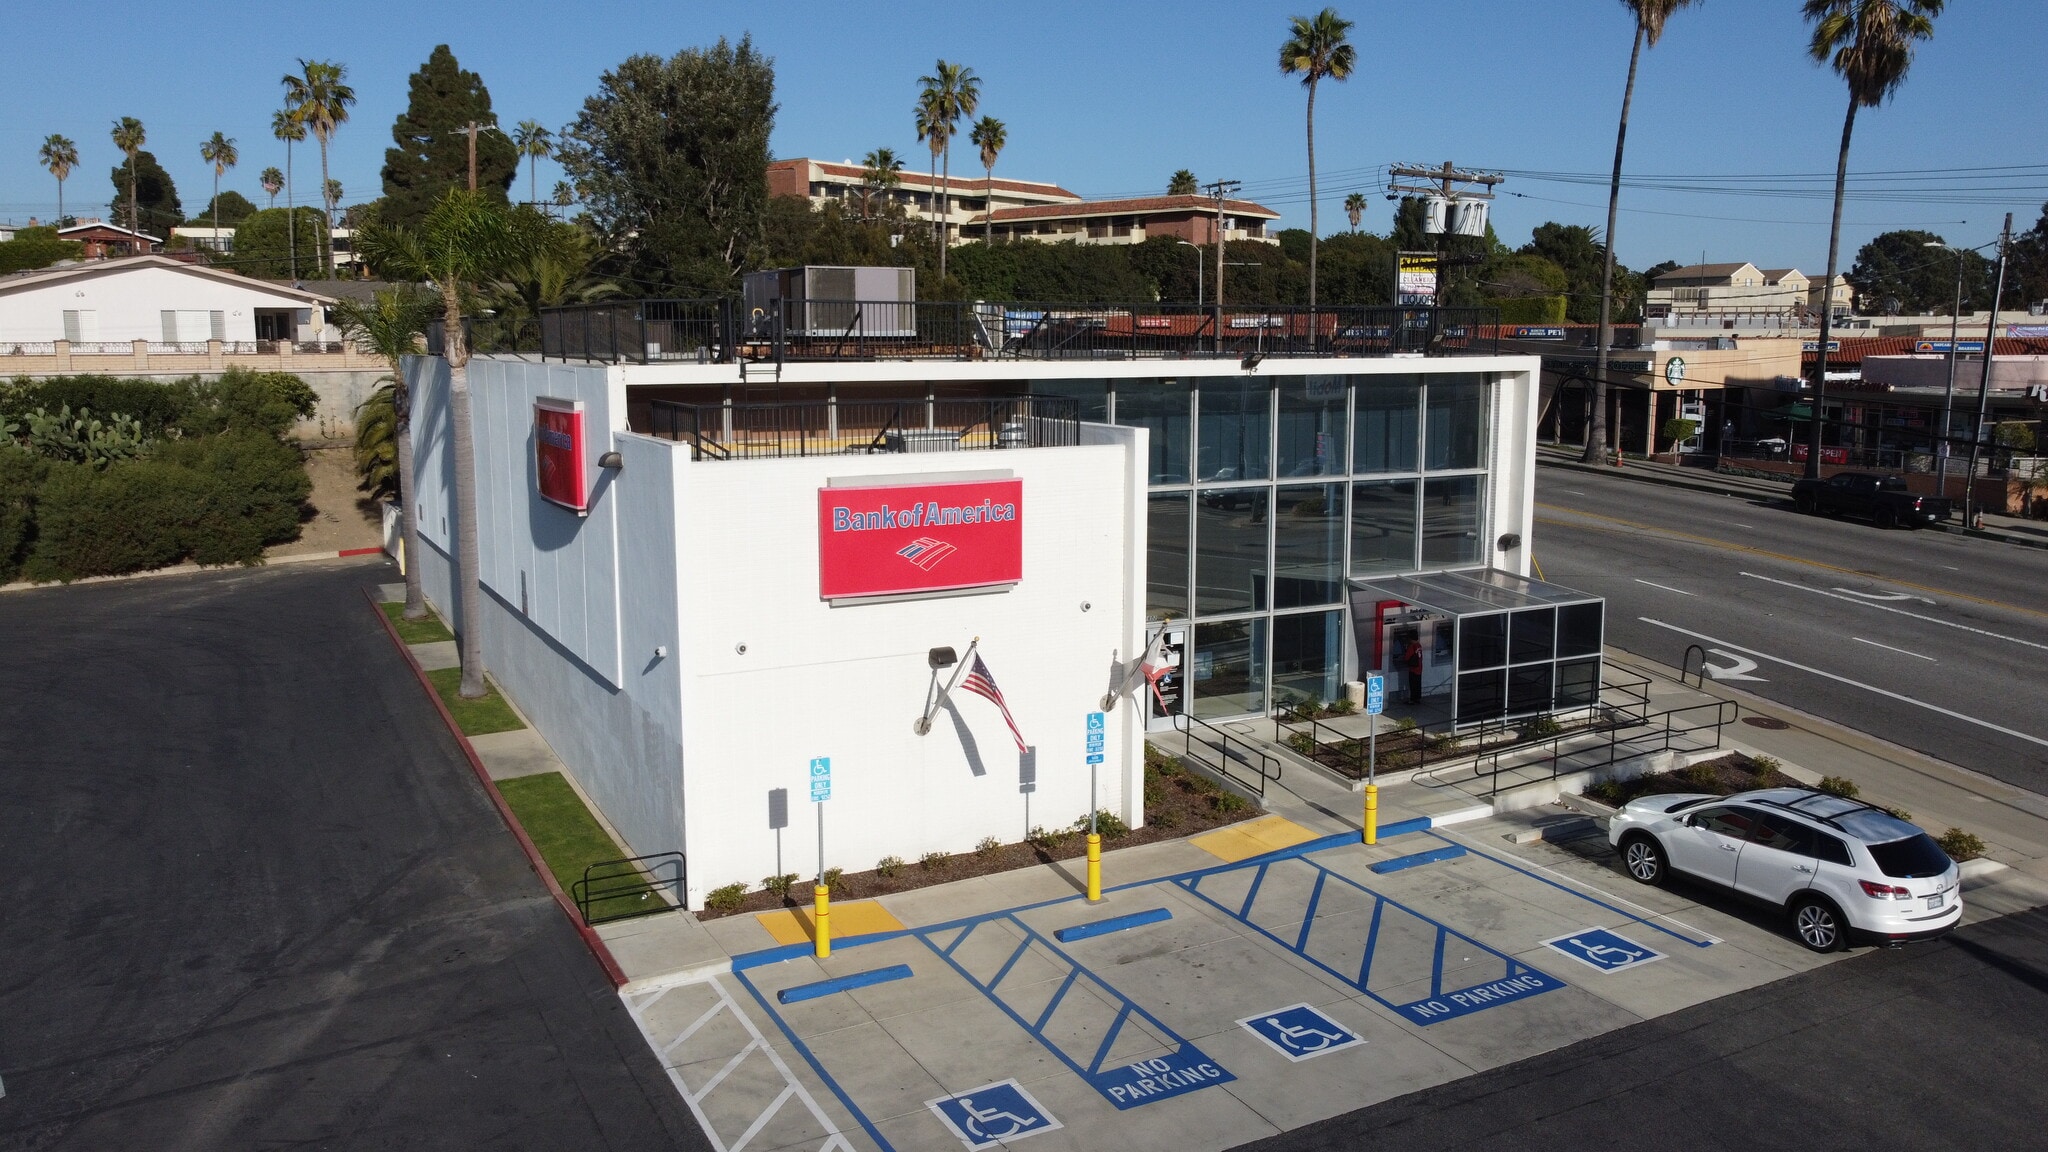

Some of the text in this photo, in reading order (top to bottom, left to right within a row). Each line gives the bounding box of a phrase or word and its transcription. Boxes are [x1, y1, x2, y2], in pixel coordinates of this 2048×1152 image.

[1402, 294, 1436, 304] LIQUOR
[1819, 449, 1842, 458] OPEN
[833, 498, 1015, 532] Bank of America
[1410, 975, 1544, 1018] NO PARKING
[1107, 1058, 1221, 1103] NO PARKING
